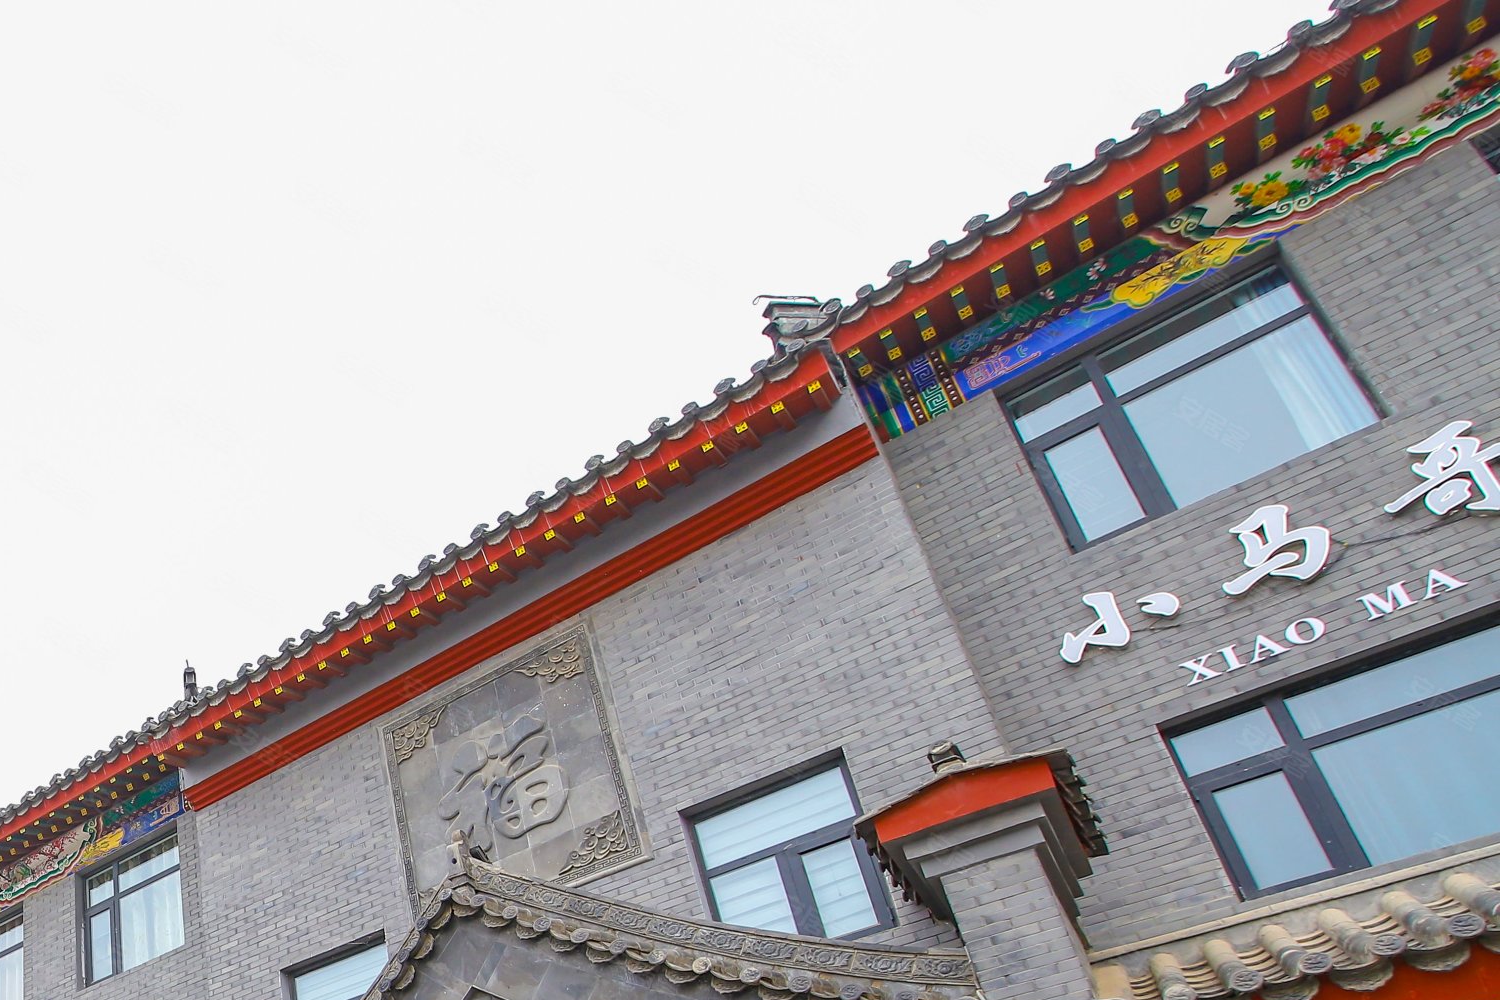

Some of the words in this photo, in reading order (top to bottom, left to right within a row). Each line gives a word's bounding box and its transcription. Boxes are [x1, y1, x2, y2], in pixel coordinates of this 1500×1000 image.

[1059, 420, 1500, 664] 小马哥
[1179, 617, 1326, 687] XIAO
[1356, 568, 1468, 621] MA
[438, 713, 570, 852] 福
